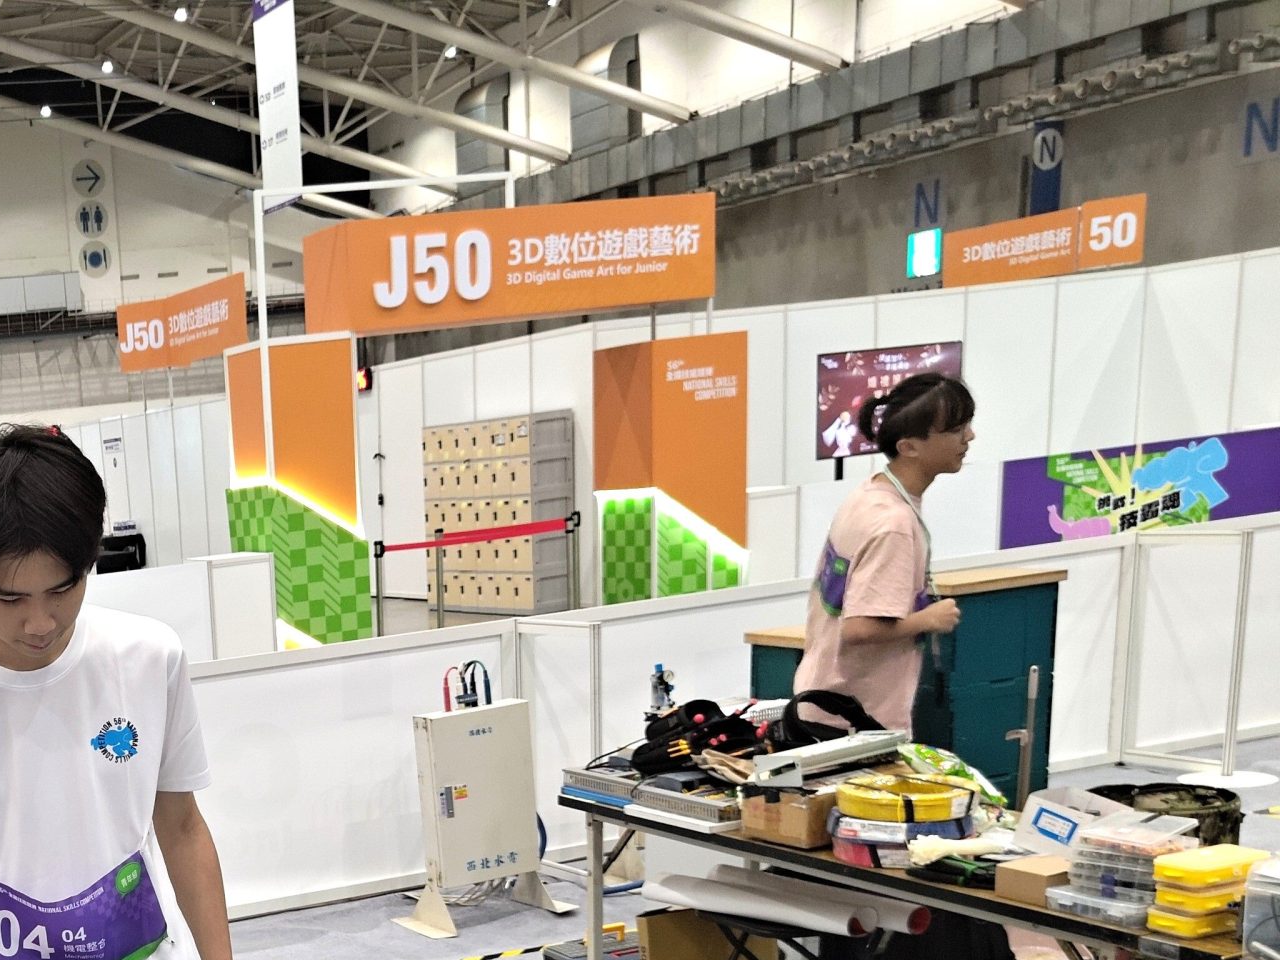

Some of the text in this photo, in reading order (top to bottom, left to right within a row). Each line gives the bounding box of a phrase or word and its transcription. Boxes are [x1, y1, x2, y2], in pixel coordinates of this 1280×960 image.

[1039, 136, 1057, 162] N
[914, 179, 940, 227] N
[507, 224, 700, 266] 3D數位遊戲藝術
[1089, 212, 1137, 251] 50
[373, 229, 493, 309] J50
[506, 260, 669, 285] 3D Digital Game Art for Junior
[120, 318, 164, 354] J50
[62, 926, 87, 943] 04
